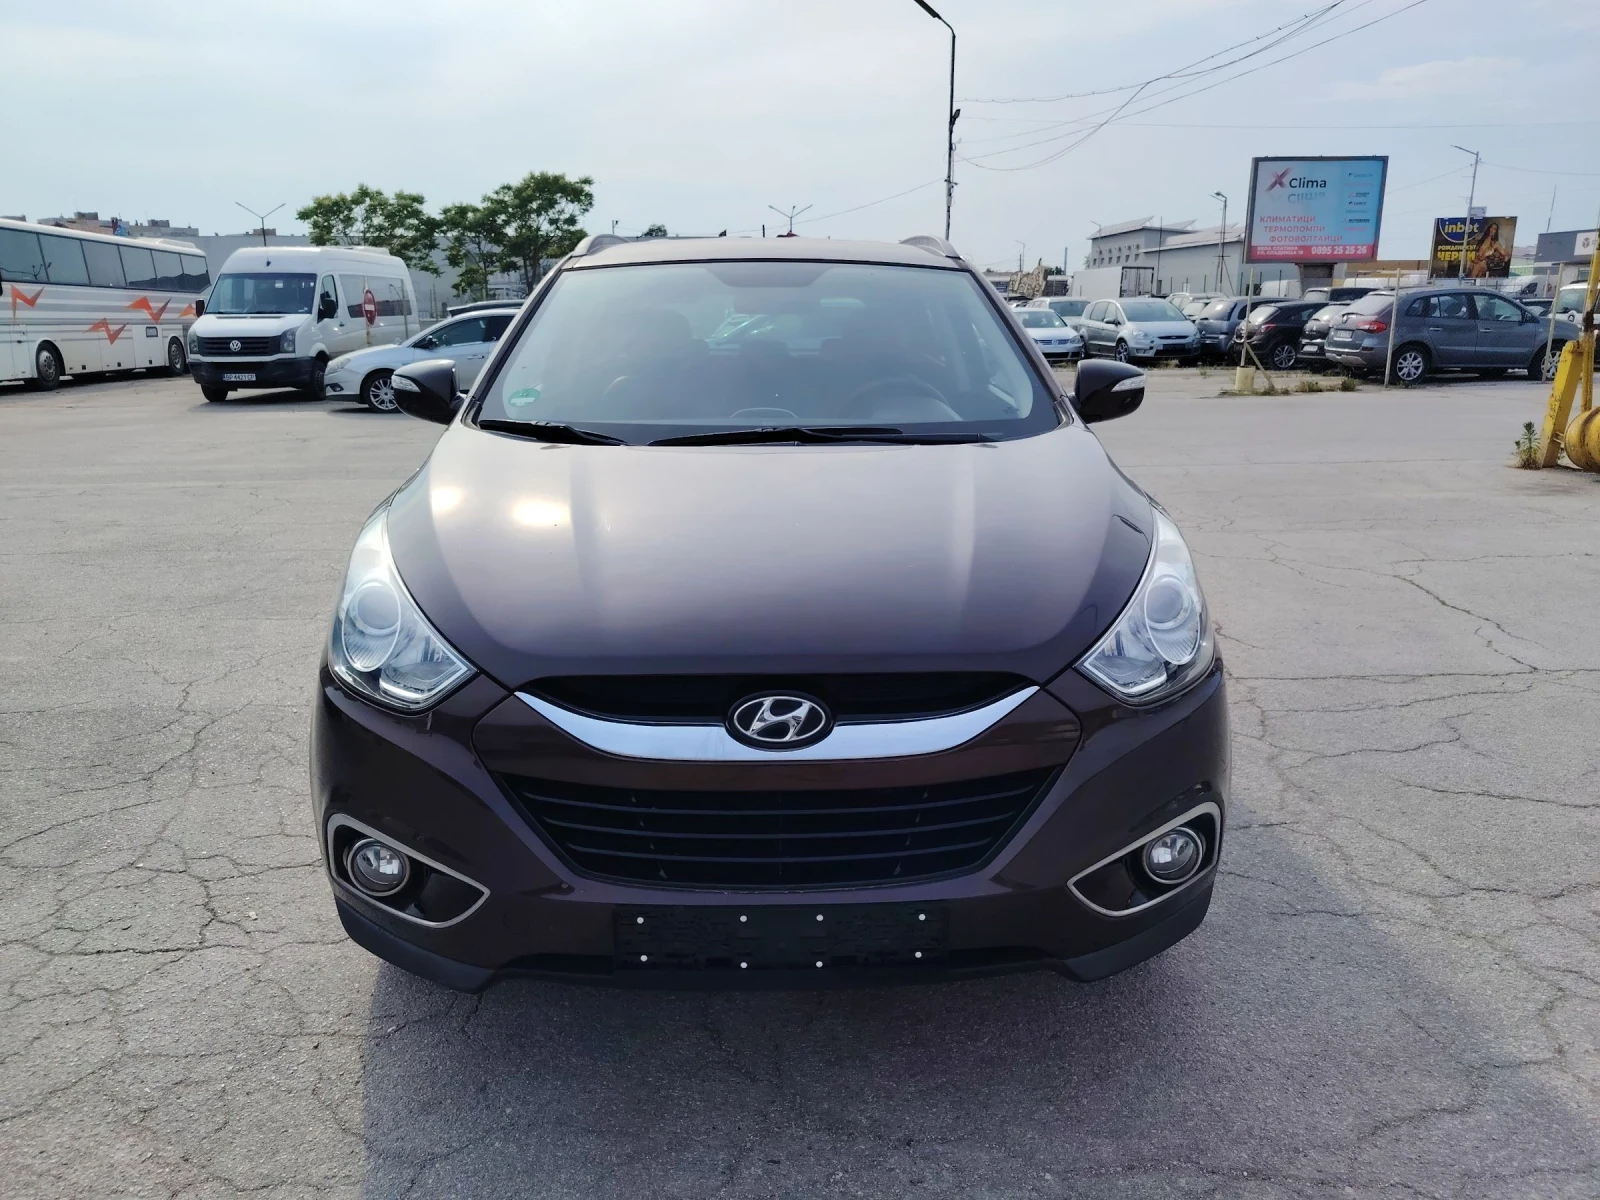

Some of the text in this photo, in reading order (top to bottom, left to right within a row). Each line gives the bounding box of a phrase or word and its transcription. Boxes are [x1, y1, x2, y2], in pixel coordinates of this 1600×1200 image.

[1289, 177, 1327, 188] Clima
[1259, 215, 1316, 223] КЛИМАТИЦИ
[1263, 225, 1326, 233] ТЕРМОПОМПИ
[1269, 235, 1343, 243] ФОТОВОЛТАИЦИ
[1311, 245, 1333, 255] 0895
[1333, 245, 1343, 254] 25
[1345, 245, 1355, 254] 25
